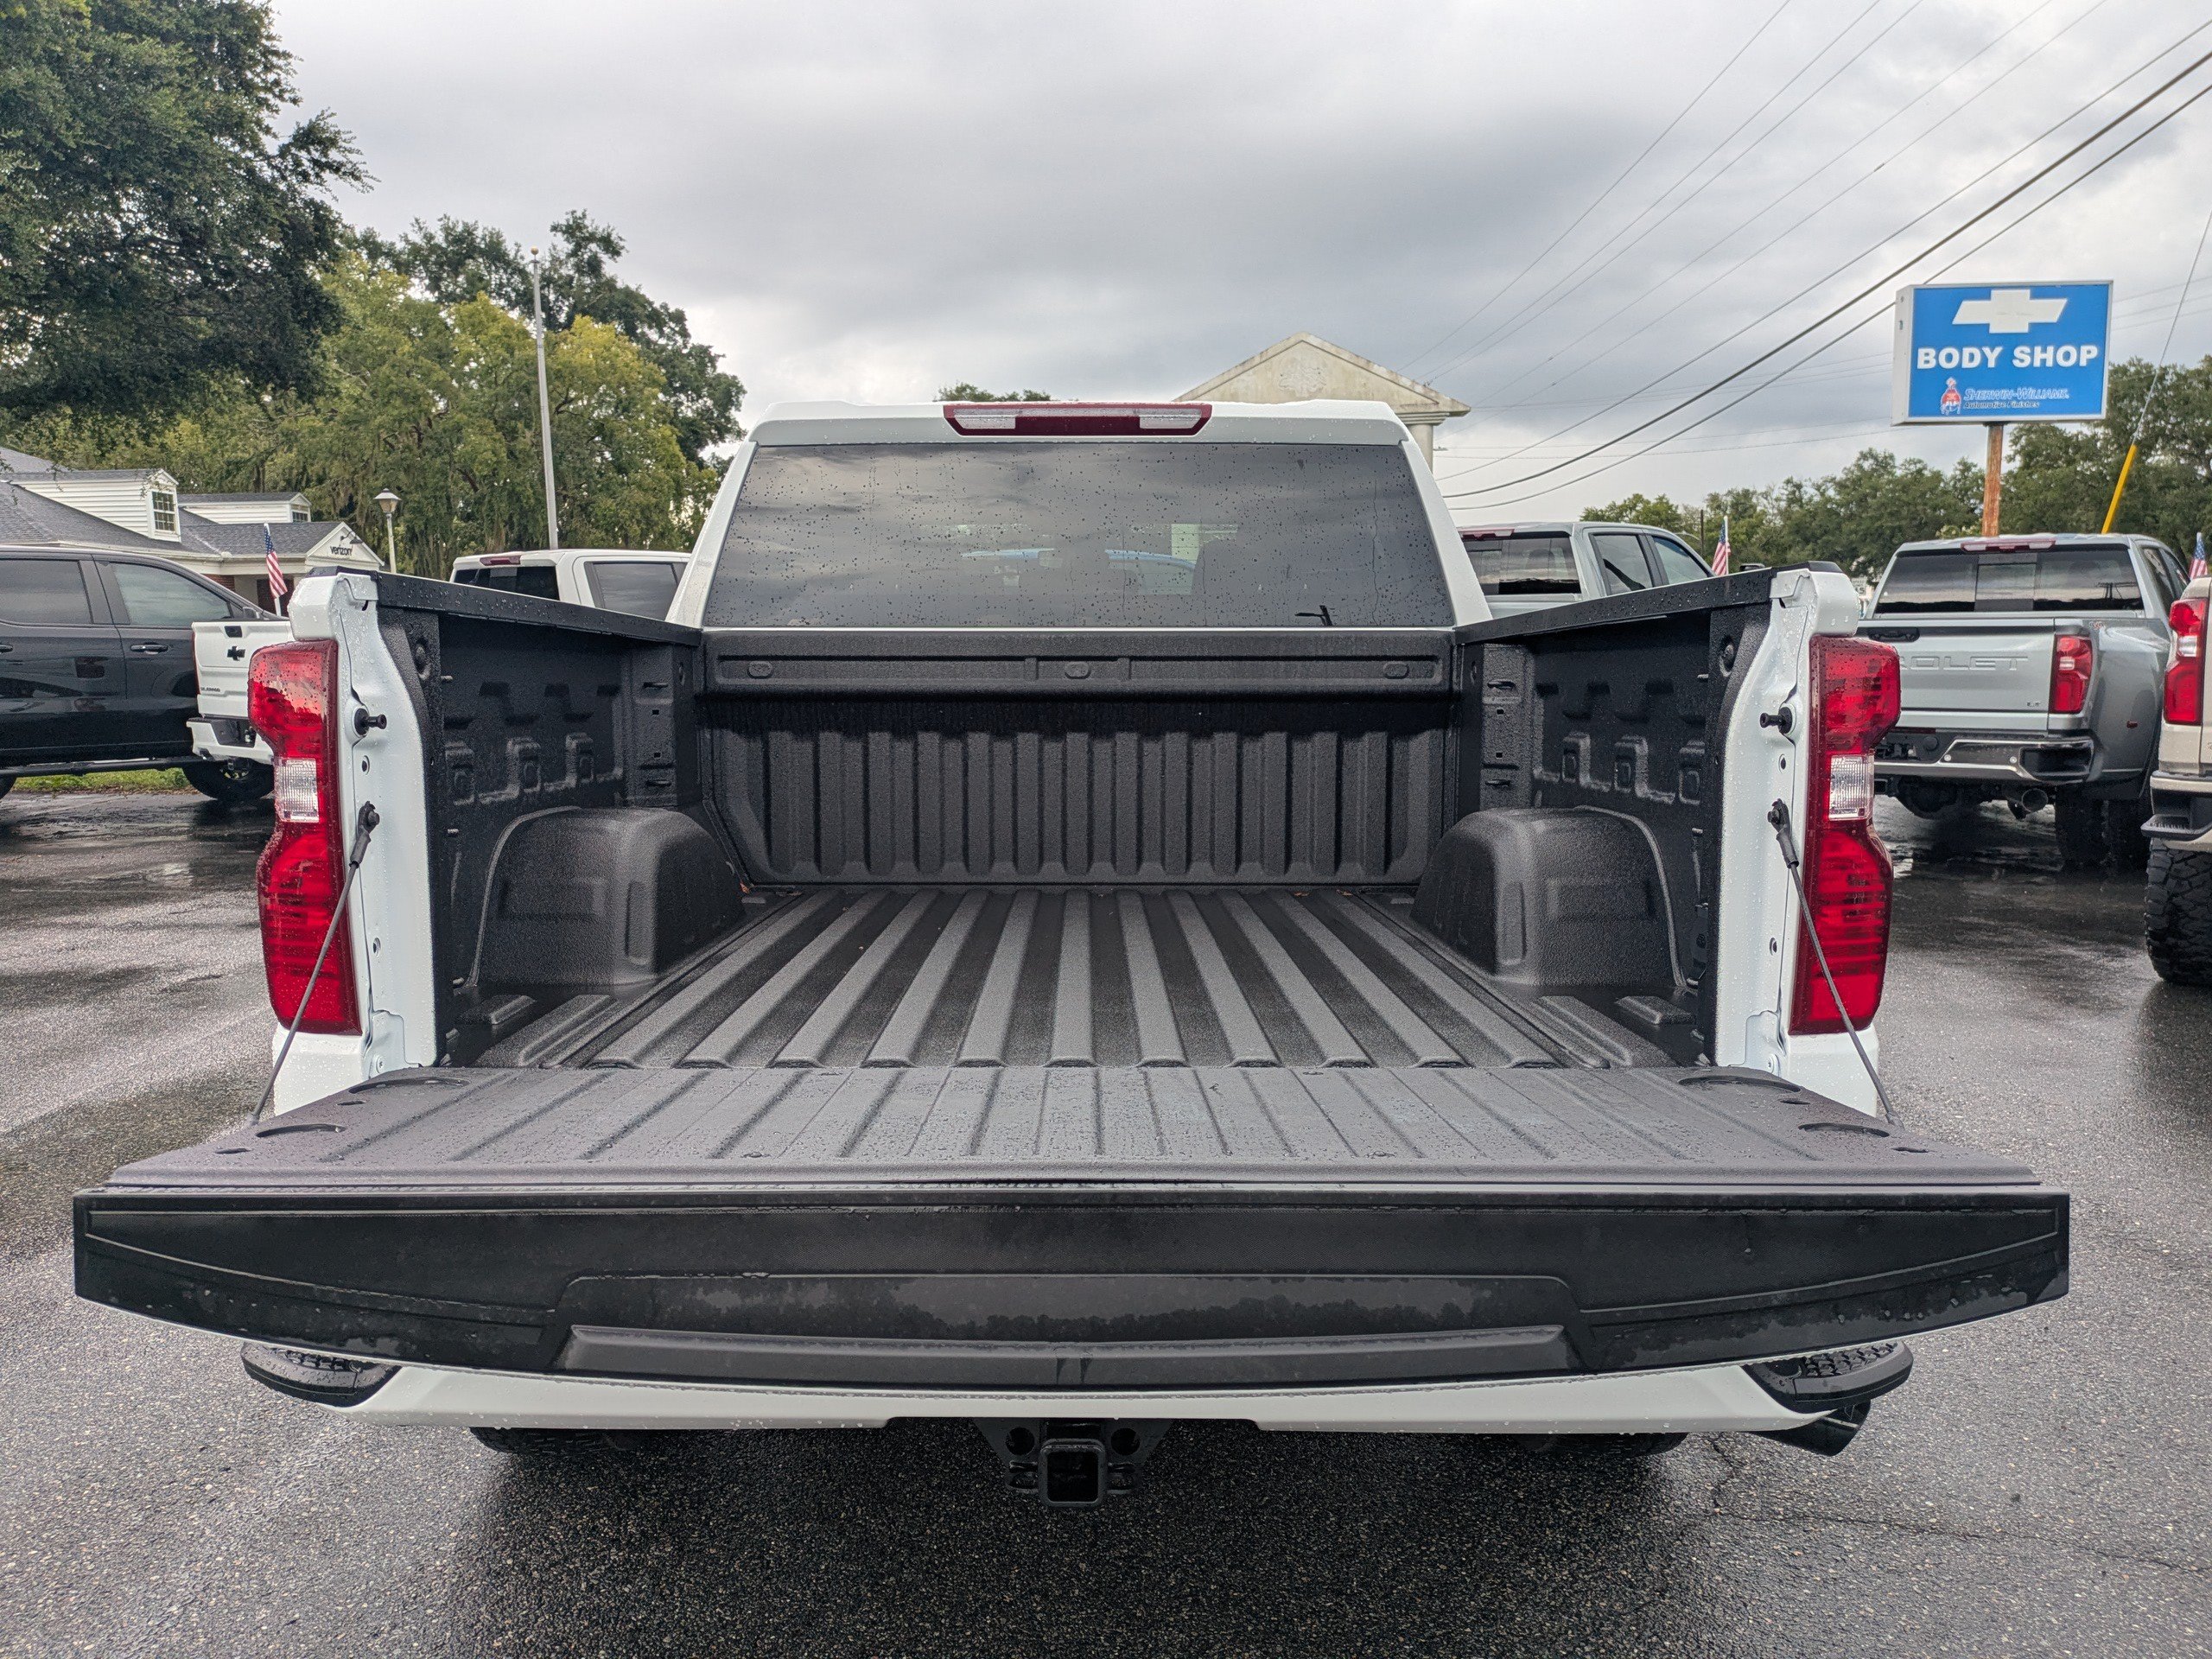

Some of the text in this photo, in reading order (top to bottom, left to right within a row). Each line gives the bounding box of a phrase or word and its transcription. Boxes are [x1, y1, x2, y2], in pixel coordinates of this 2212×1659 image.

[1916, 345, 2098, 370] BODY SHOP
[329, 544, 353, 556] verizon
